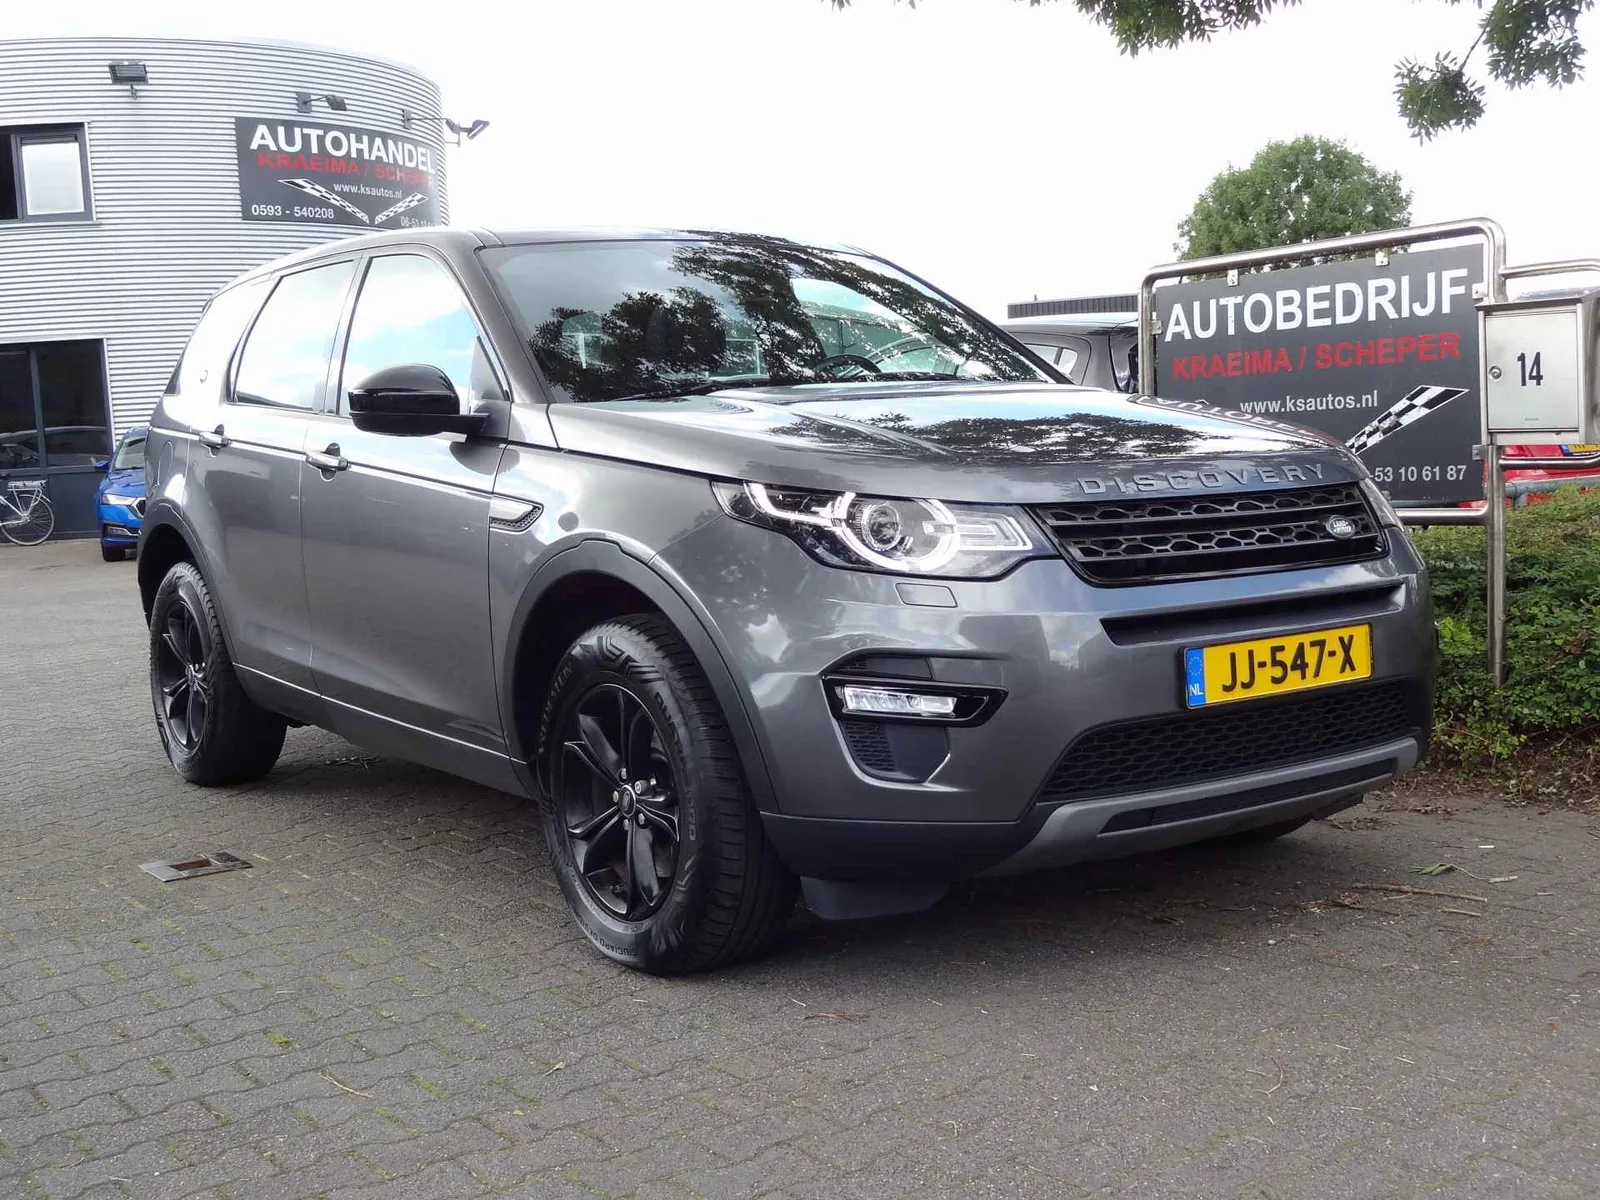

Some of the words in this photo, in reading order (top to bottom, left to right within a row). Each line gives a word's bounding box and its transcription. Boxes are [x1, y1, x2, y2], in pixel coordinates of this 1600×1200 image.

[249, 124, 435, 174] AUTOHANDEL
[257, 152, 361, 176] KRAEIMA
[333, 182, 402, 199] www.ksautos.nl
[251, 204, 282, 216] 0593
[293, 207, 334, 219] 540208
[1164, 268, 1468, 342] AUTOBEDRIJF
[1172, 347, 1293, 380] KRAEIMA
[1314, 332, 1461, 369] SCHEPER
[1517, 351, 1544, 387] 14
[1240, 389, 1378, 414] www.ksautos.nl
[1077, 463, 1326, 494] DISCOVERY
[1398, 466, 1418, 482] 10
[1422, 465, 1440, 481] 61
[1446, 465, 1467, 481] 87
[1222, 634, 1357, 693] JJ-547-X
[1189, 682, 1204, 697] NL
